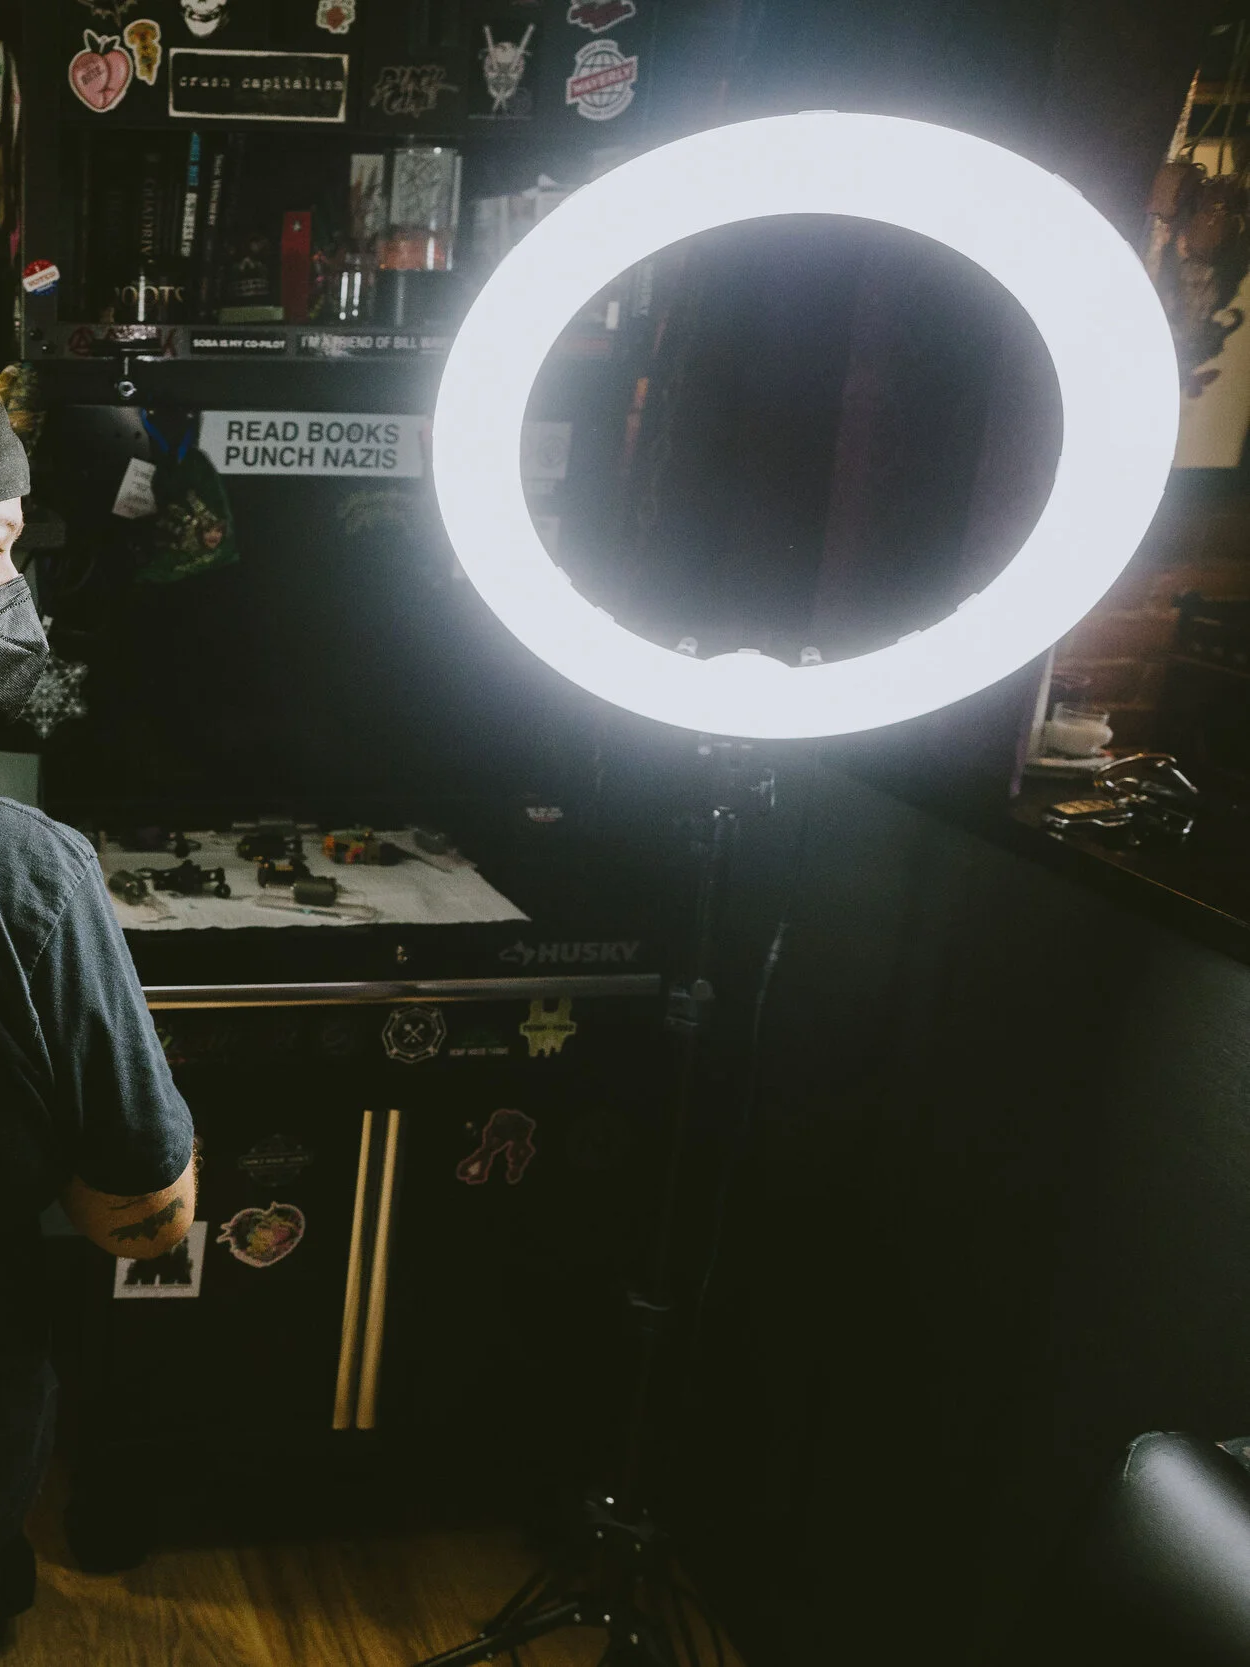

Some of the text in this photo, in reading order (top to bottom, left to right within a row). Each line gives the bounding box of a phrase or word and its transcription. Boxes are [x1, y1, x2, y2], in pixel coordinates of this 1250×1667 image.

[244, 339, 286, 349] CO-PILOT
[376, 336, 391, 348] OF
[393, 336, 417, 349] BILL
[227, 421, 400, 444] READ BOOKS
[224, 446, 398, 469] PUNCH NAZIS
[538, 940, 640, 963] HUSKY
